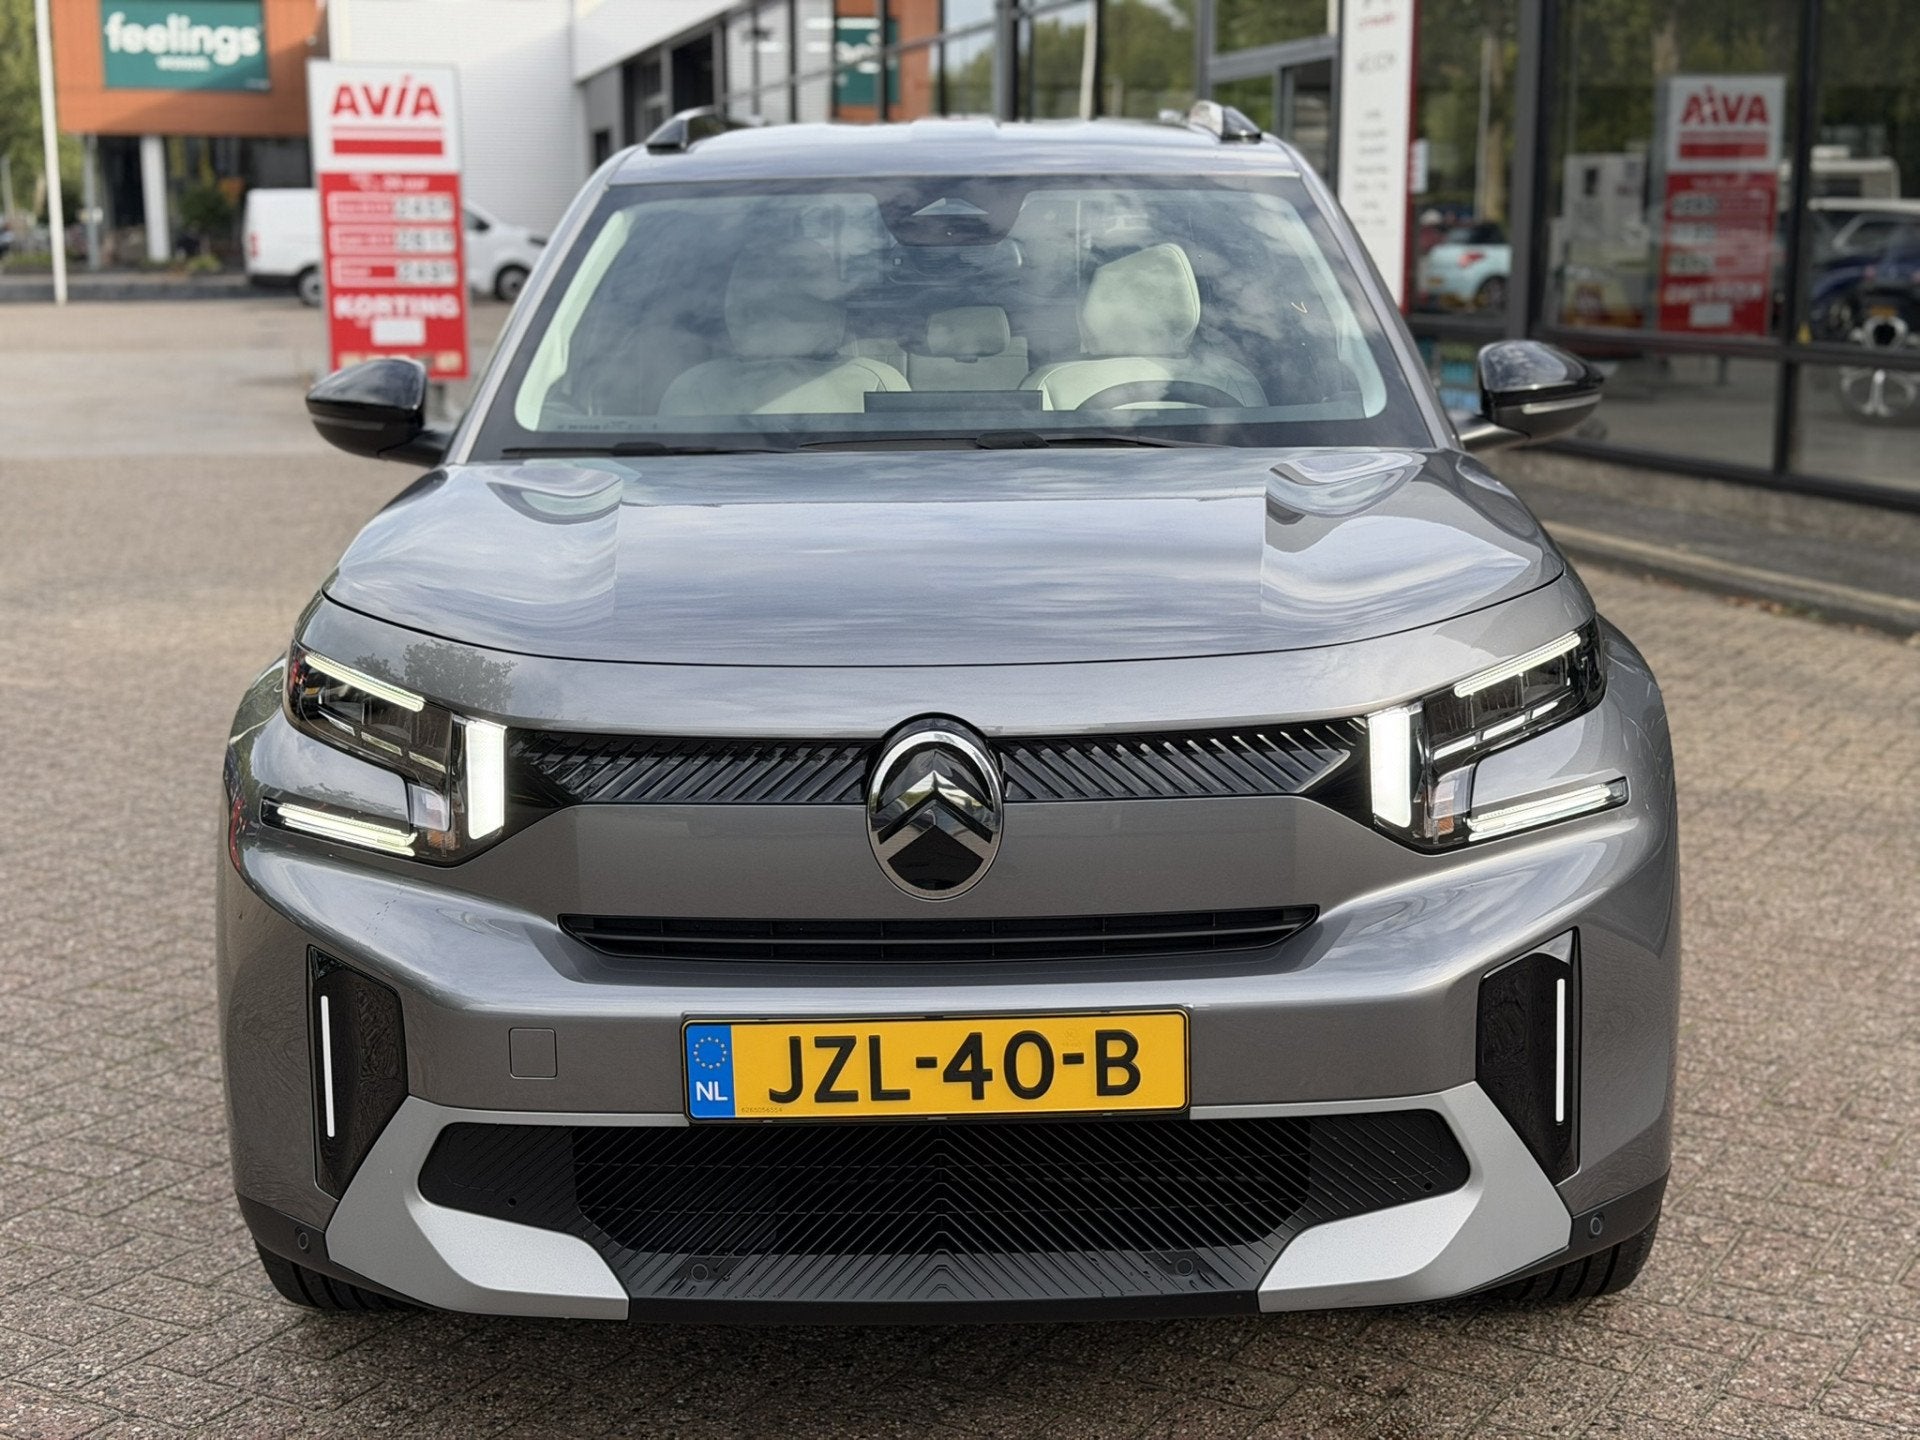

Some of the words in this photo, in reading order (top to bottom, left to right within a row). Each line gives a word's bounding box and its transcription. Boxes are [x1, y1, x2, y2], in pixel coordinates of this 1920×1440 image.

[104, 11, 260, 66] feelings
[332, 74, 440, 116] AVIA
[769, 1029, 1141, 1103] JZL-40-B
[696, 1081, 728, 1101] NL
